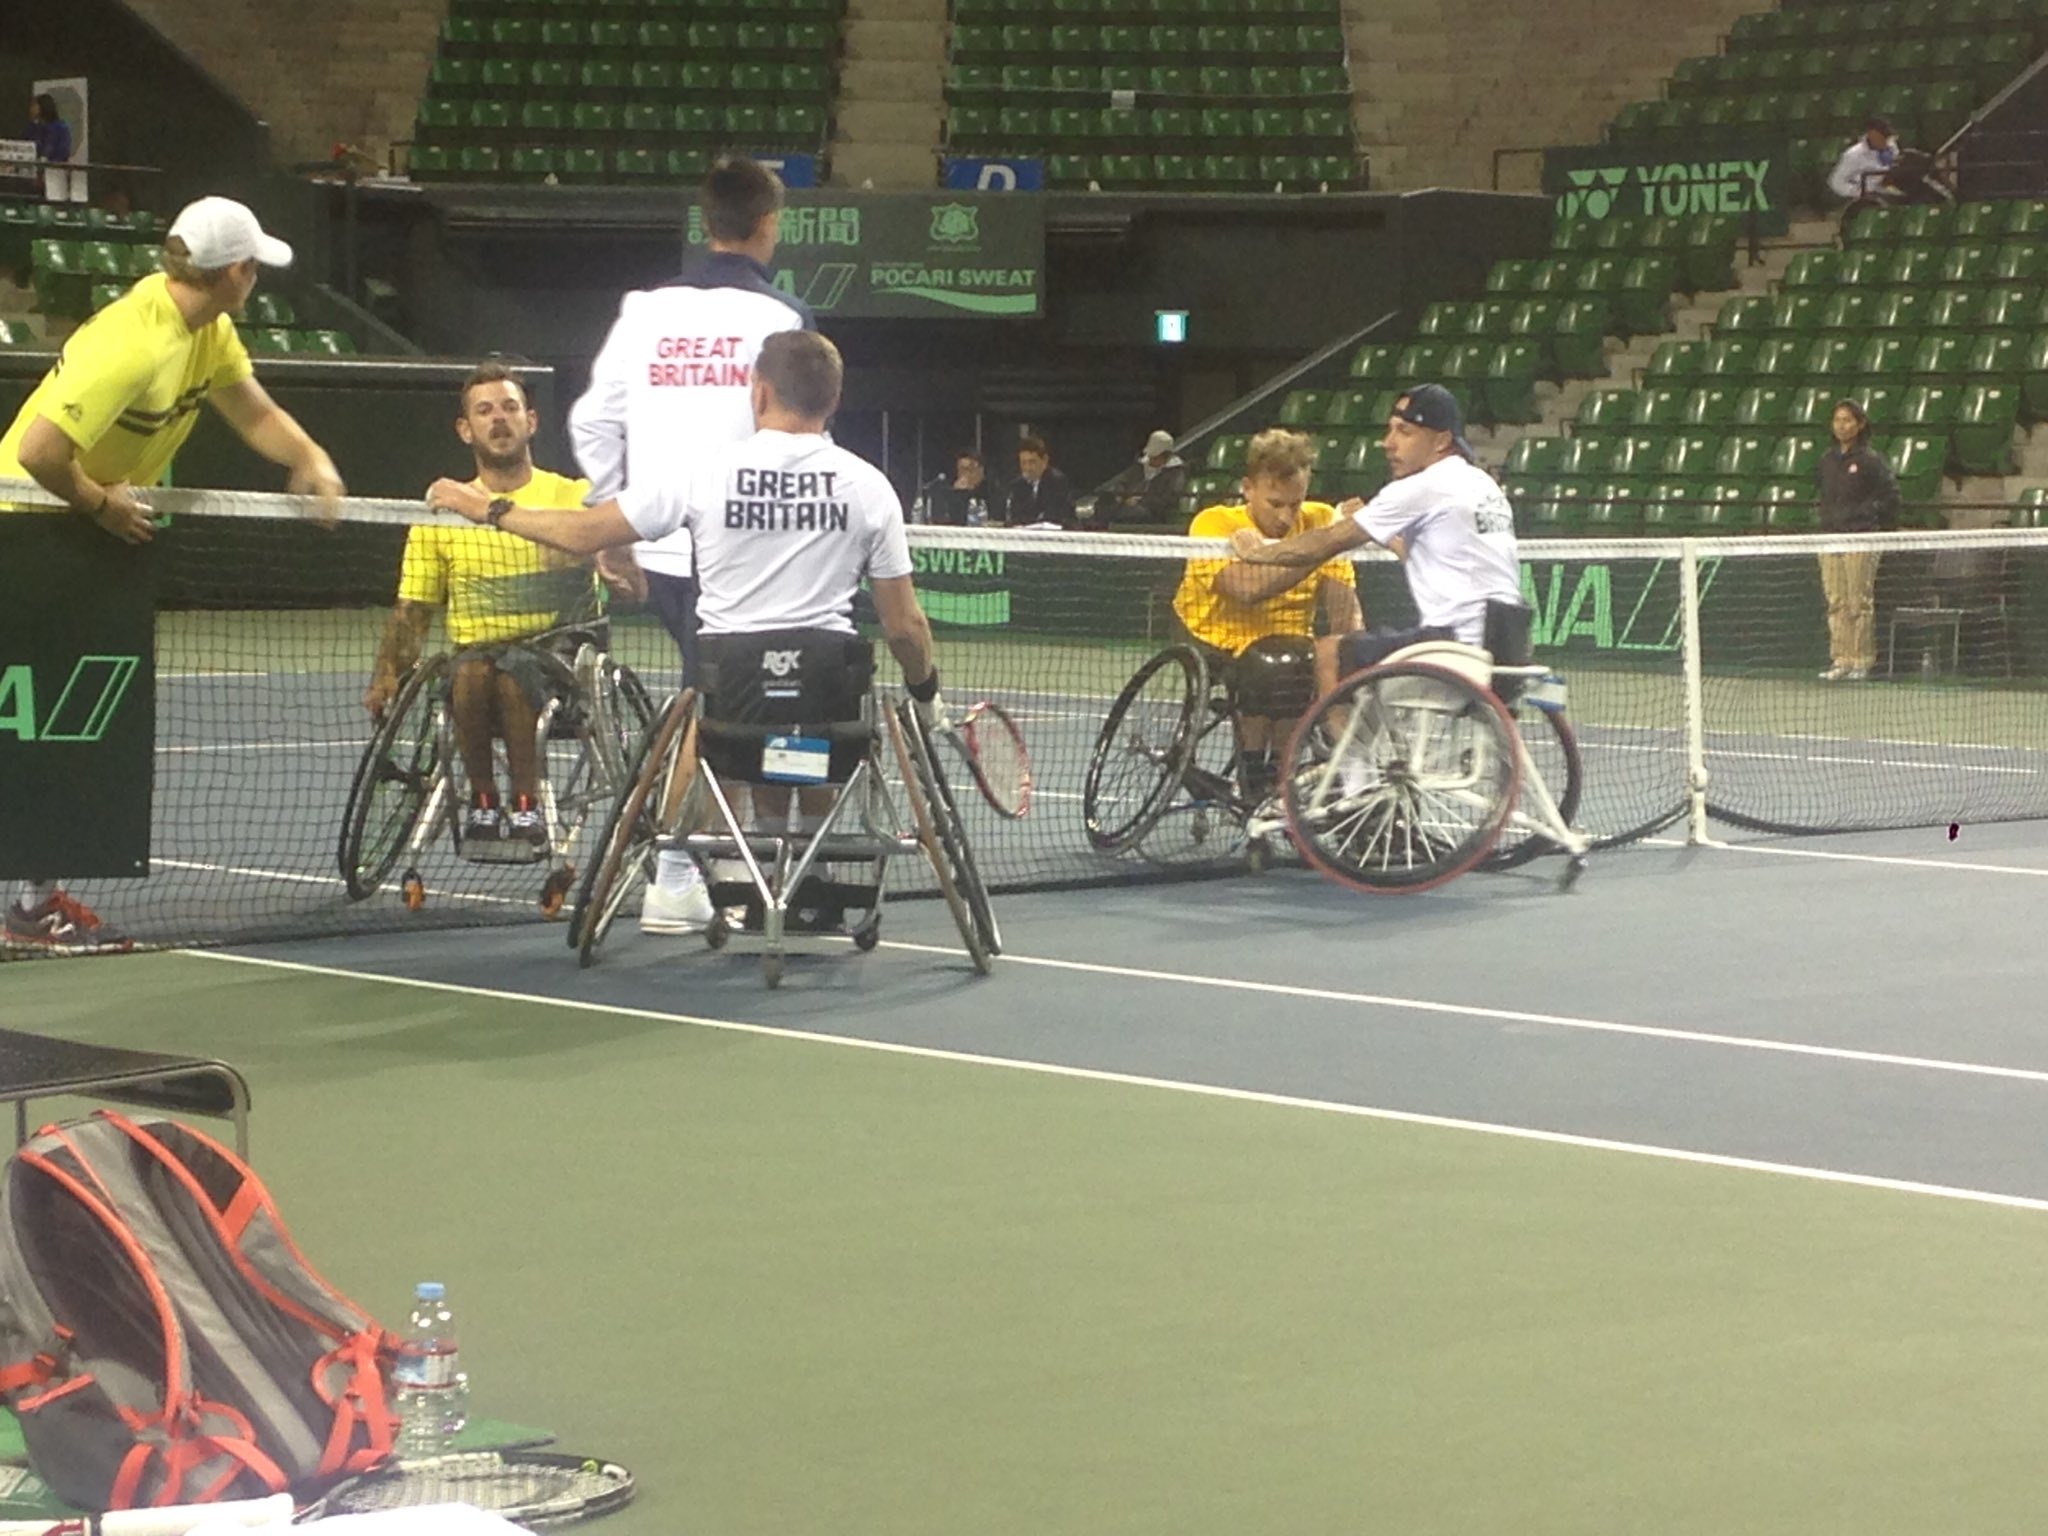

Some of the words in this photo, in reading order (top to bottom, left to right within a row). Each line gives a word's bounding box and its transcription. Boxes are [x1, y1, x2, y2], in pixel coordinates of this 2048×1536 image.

[1636, 159, 1770, 217] YONEX
[870, 268, 953, 286] POCARI
[958, 269, 1037, 287] SWEAT
[657, 336, 743, 359] GREAT
[648, 363, 750, 387] BRITAIN
[736, 468, 837, 500] GREAT
[724, 500, 850, 533] BRITAIN
[911, 547, 1006, 575] SWEAT
[1518, 562, 1614, 648] NA
